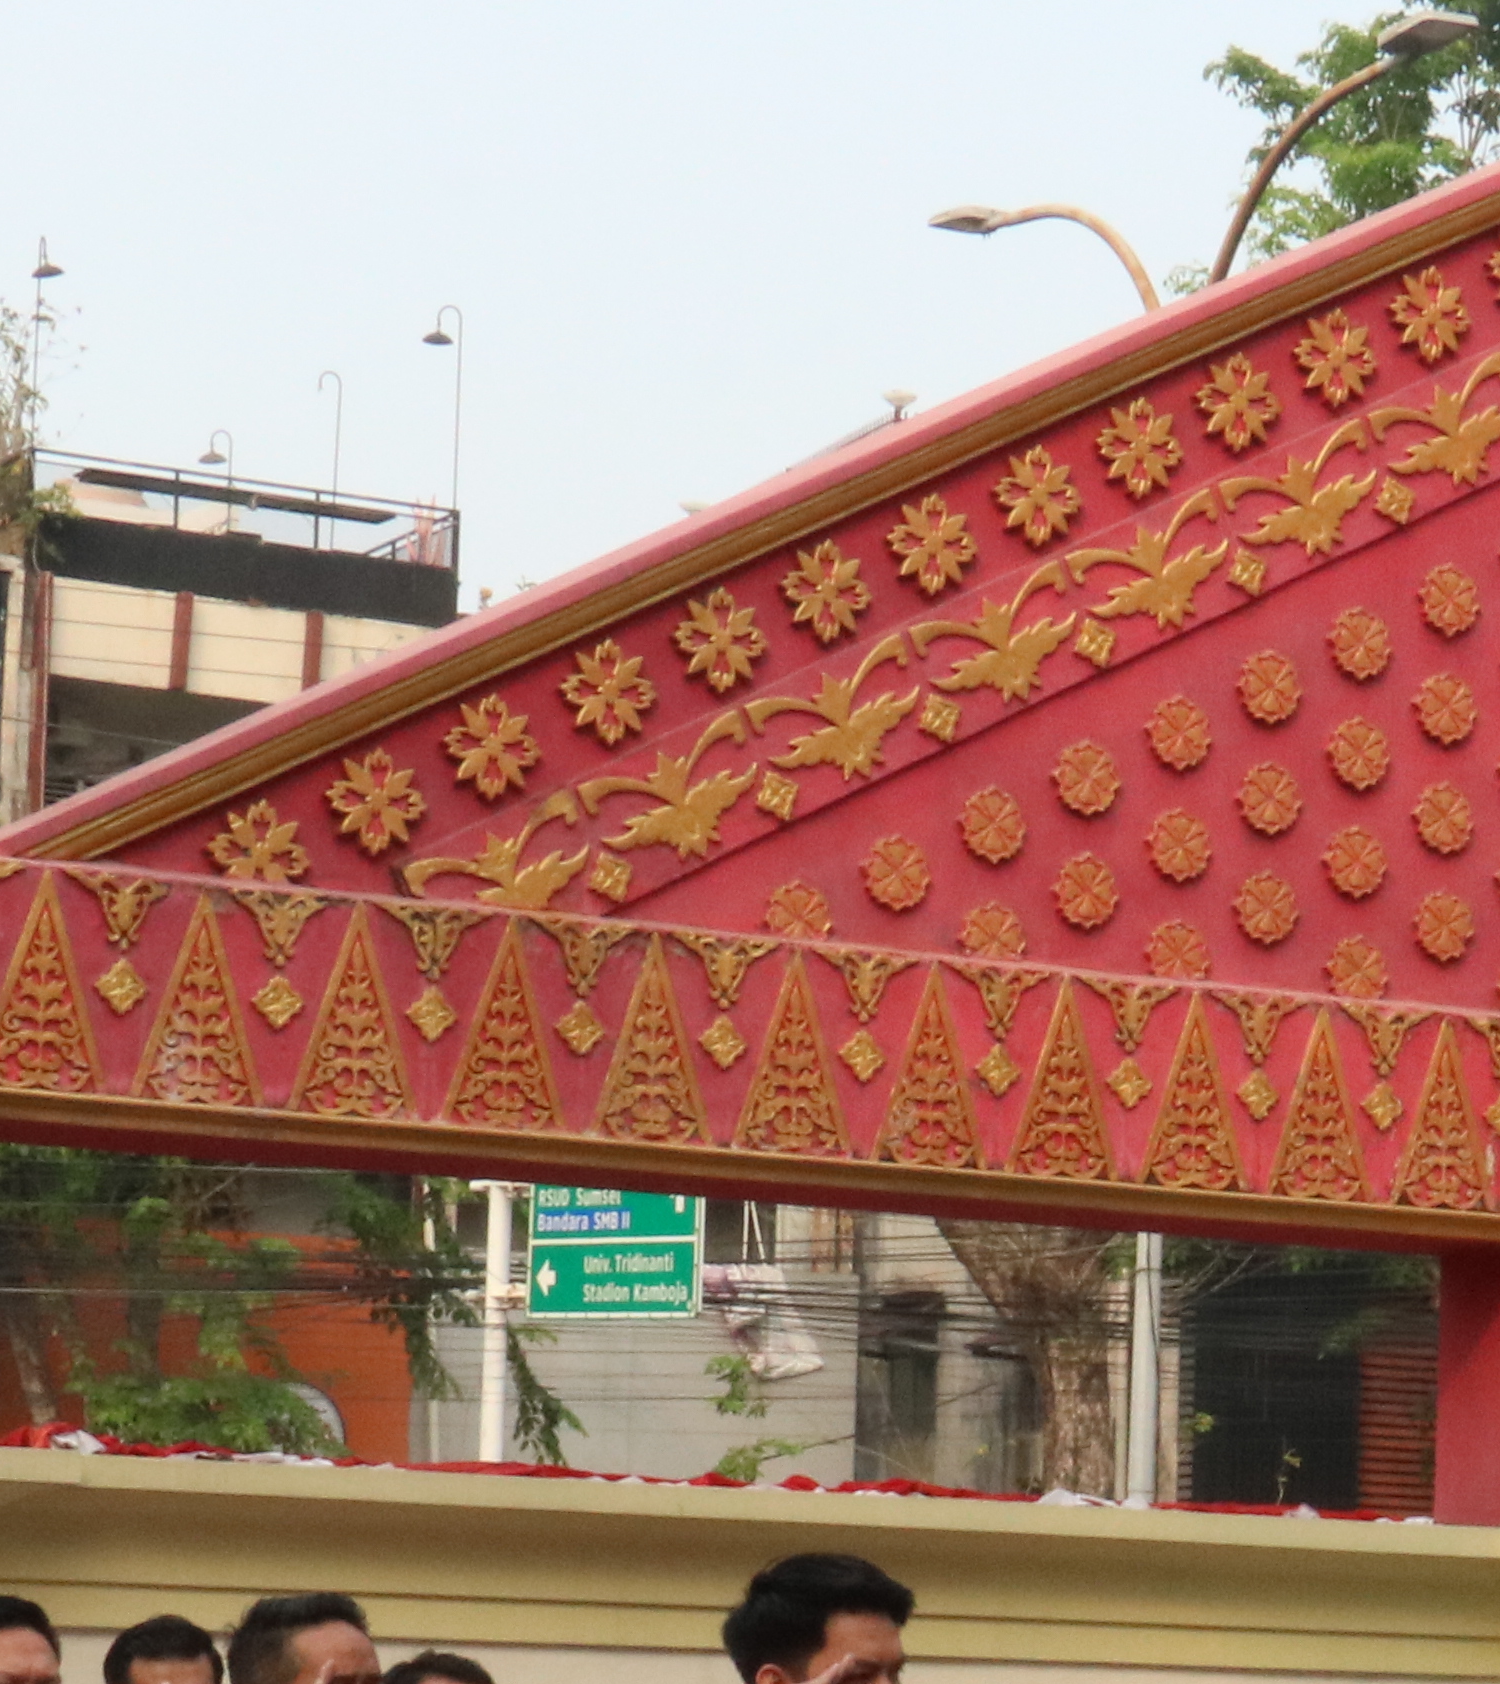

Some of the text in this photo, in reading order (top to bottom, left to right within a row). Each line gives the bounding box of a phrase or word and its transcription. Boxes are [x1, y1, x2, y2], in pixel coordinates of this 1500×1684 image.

[538, 1188, 570, 1207] RSUD
[536, 1212, 589, 1232] Bandara
[593, 1210, 619, 1230] SMB
[583, 1254, 612, 1274] Univ.
[582, 1281, 689, 1306] Stadion Kamboja
